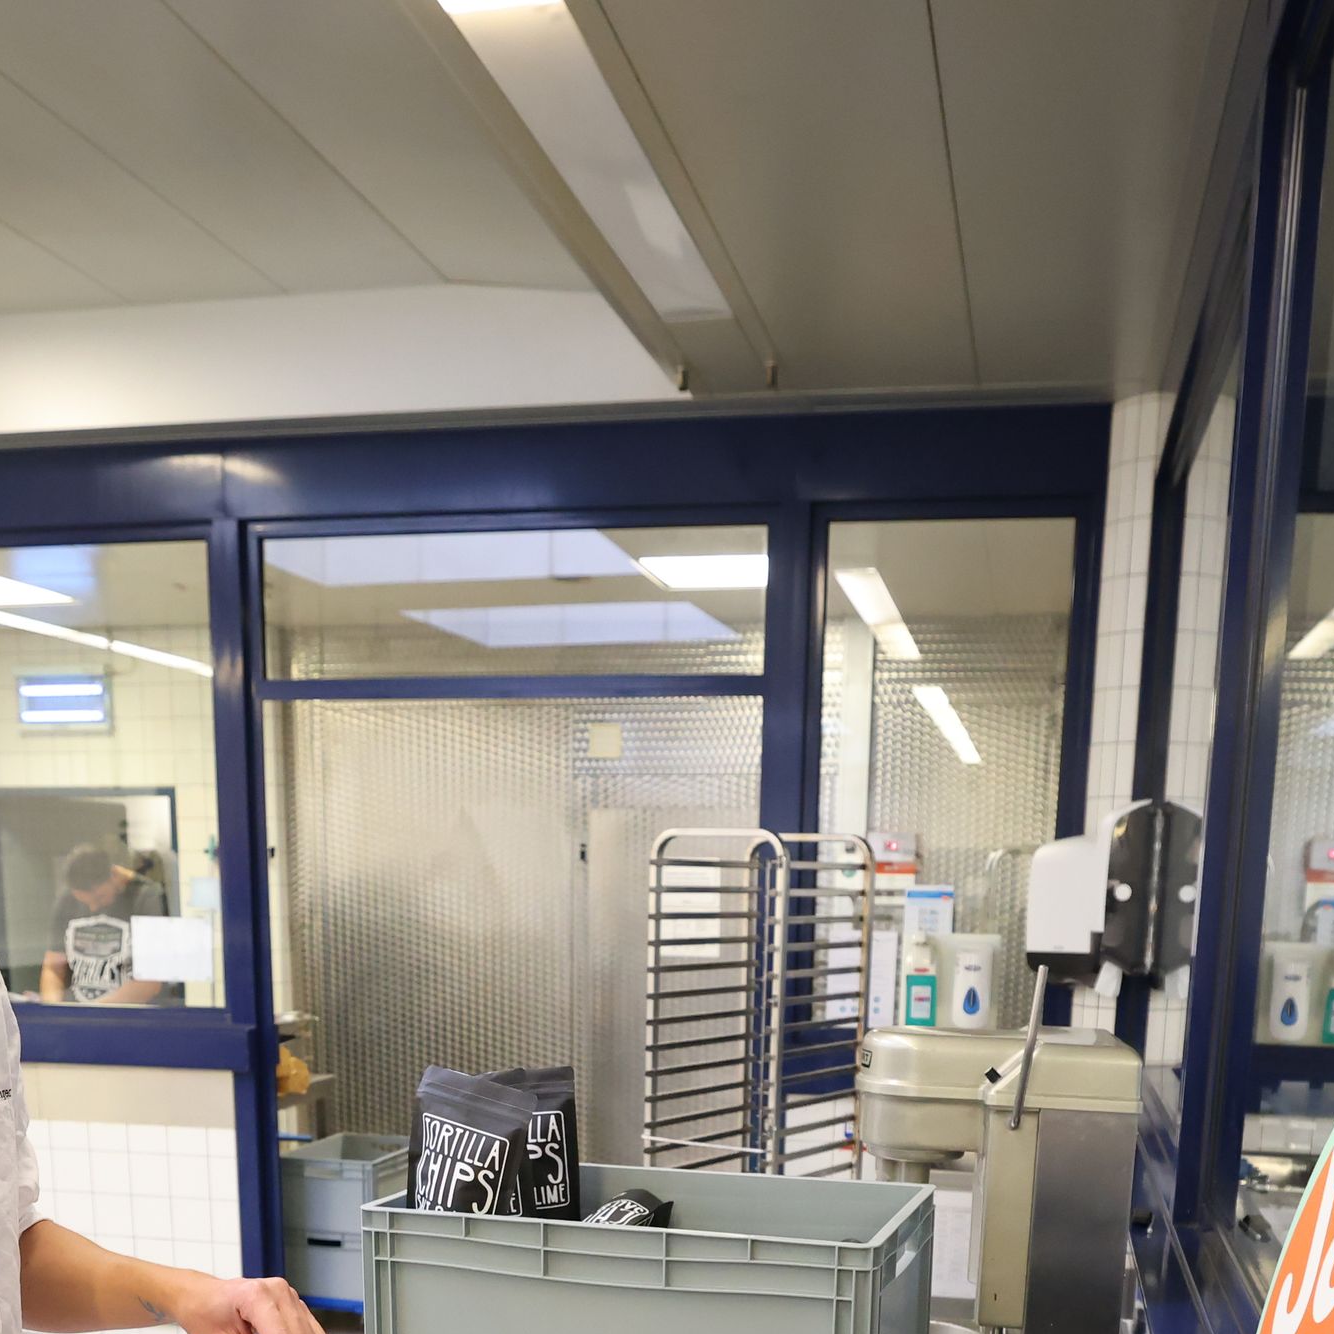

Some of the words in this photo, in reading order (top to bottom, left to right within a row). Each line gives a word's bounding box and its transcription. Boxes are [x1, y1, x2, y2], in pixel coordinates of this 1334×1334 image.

[424, 1117, 501, 1172] TORTILLA
[417, 1148, 495, 1216] CHIPS
[533, 1183, 566, 1206] LIME
